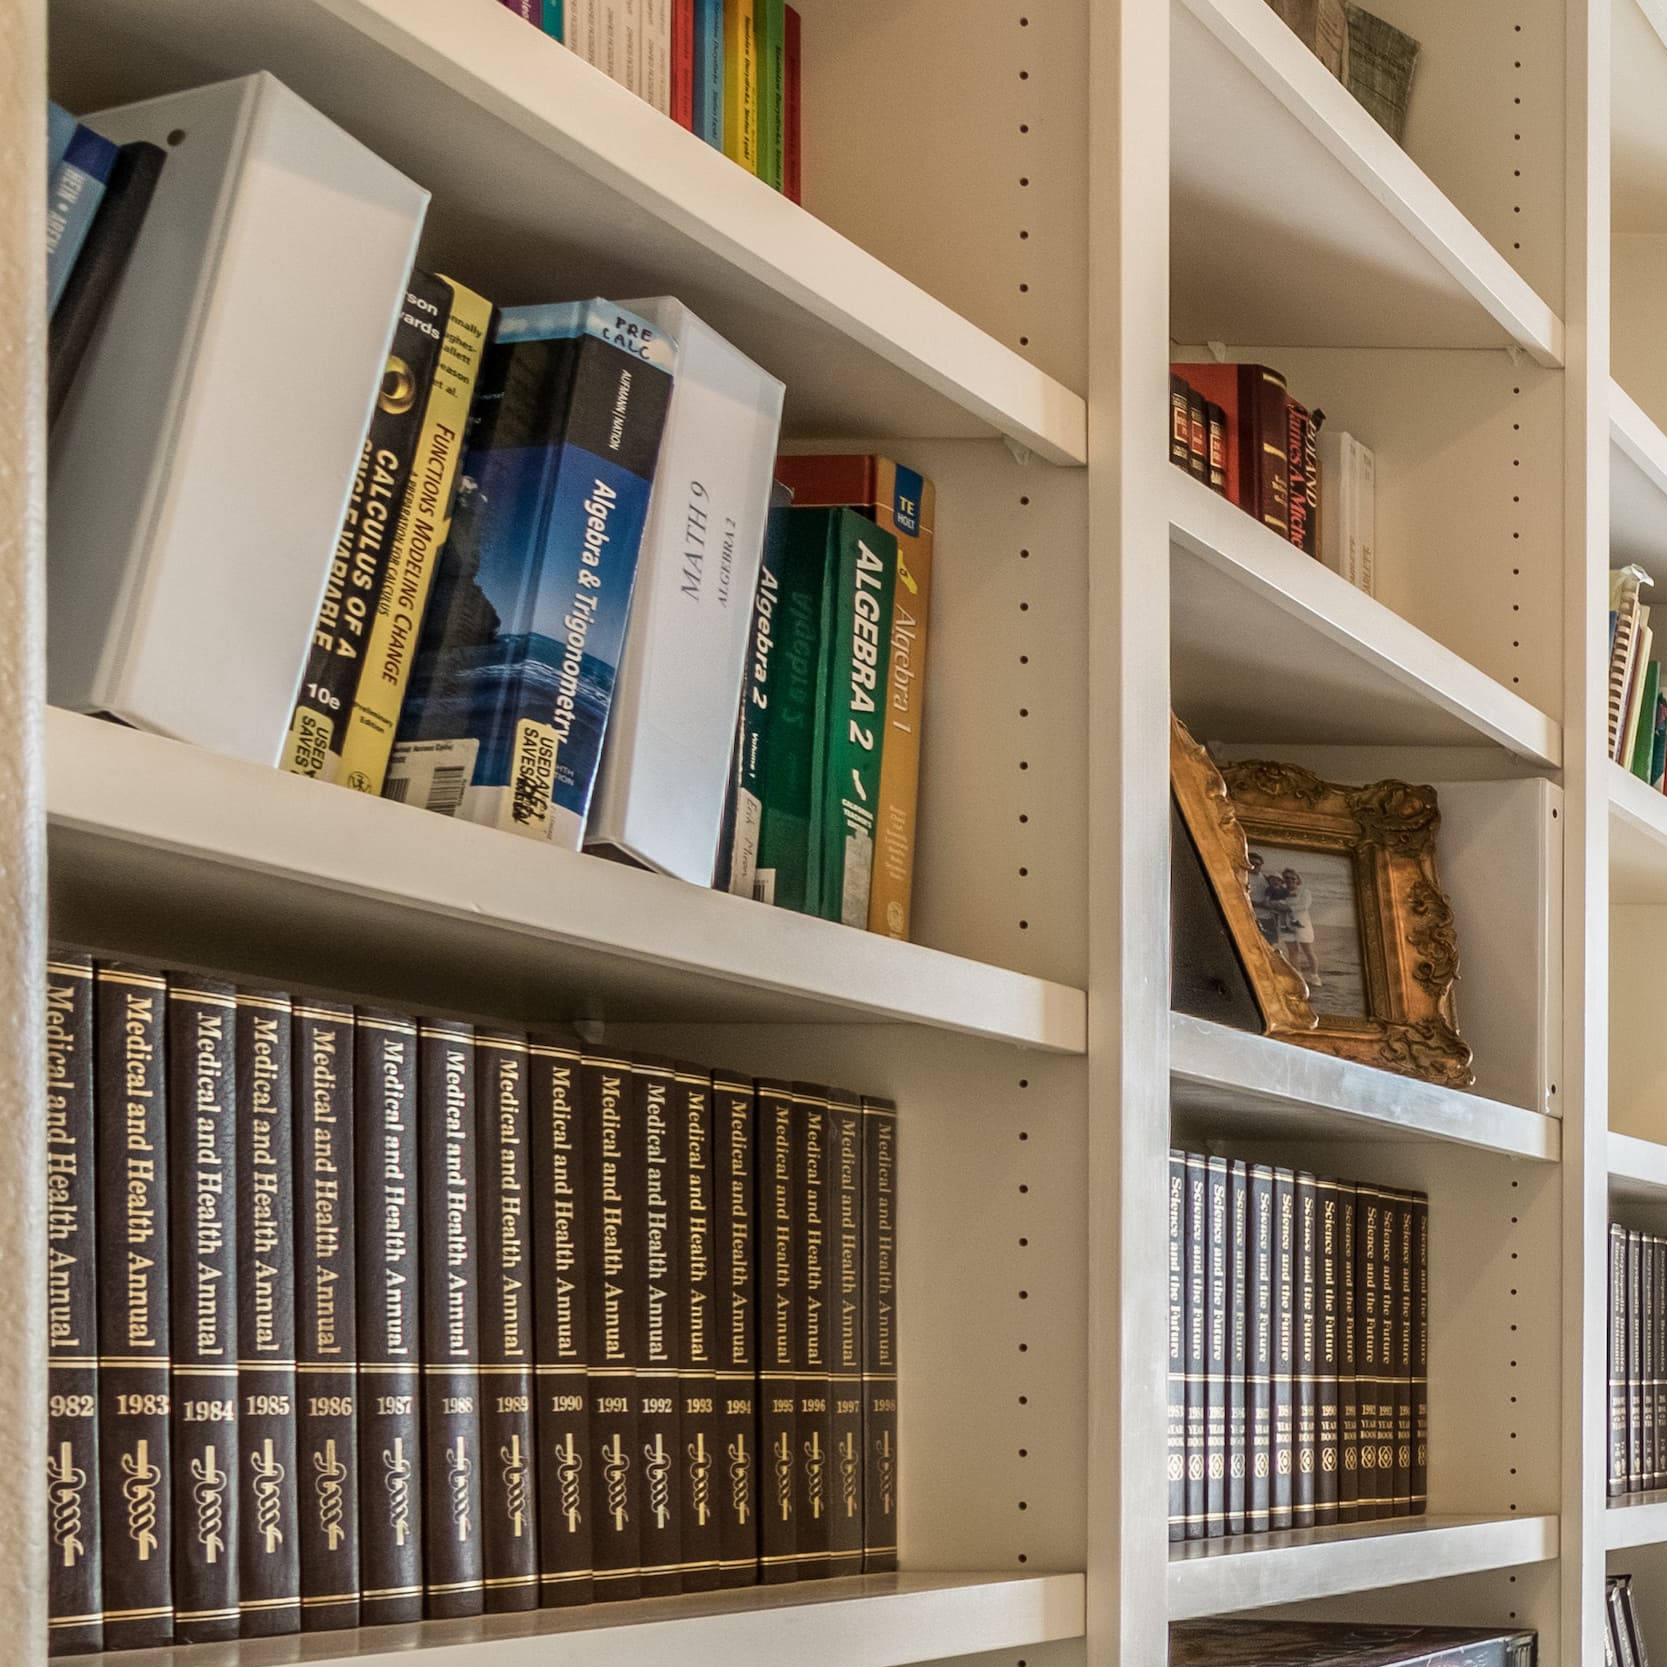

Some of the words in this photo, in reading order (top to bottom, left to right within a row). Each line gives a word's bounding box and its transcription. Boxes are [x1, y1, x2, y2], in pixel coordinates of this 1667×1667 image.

[615, 316, 652, 342] PRE
[418, 423, 456, 517] FUNCTIONS
[690, 480, 710, 503] 9
[351, 449, 399, 590] CALCULUS
[582, 479, 616, 567] Algebra
[399, 519, 436, 613] MODELING
[681, 503, 709, 604] MATH
[577, 567, 602, 590] &
[345, 596, 367, 637] OF
[752, 564, 779, 680] Algebra
[849, 539, 884, 716] ALGEBRA
[335, 643, 357, 660] A
[381, 612, 413, 687] CHANGE
[551, 593, 599, 745] Trigonometry
[751, 690, 769, 711] 2
[848, 718, 874, 752] 2
[127, 994, 153, 1097] Medical
[127, 1103, 153, 1150] and
[552, 1066, 572, 1149] Medical
[554, 1154, 572, 1194] and
[127, 1158, 154, 1243] Health
[555, 1200, 574, 1271] Health
[1323, 1200, 1335, 1254] Science
[1365, 1207, 1377, 1258] Science
[1323, 1258, 1335, 1284] and
[1364, 1263, 1376, 1288] and
[128, 1251, 155, 1346] Annual
[556, 1277, 577, 1357] Annual
[1324, 1289, 1335, 1312] the
[1364, 1292, 1376, 1314] the
[1324, 1316, 1335, 1361] Future
[1363, 1318, 1375, 1361] Future
[116, 1394, 169, 1416] 1983
[183, 1400, 235, 1422] 1984
[246, 1395, 290, 1416] 1985
[309, 1396, 352, 1417] 1986
